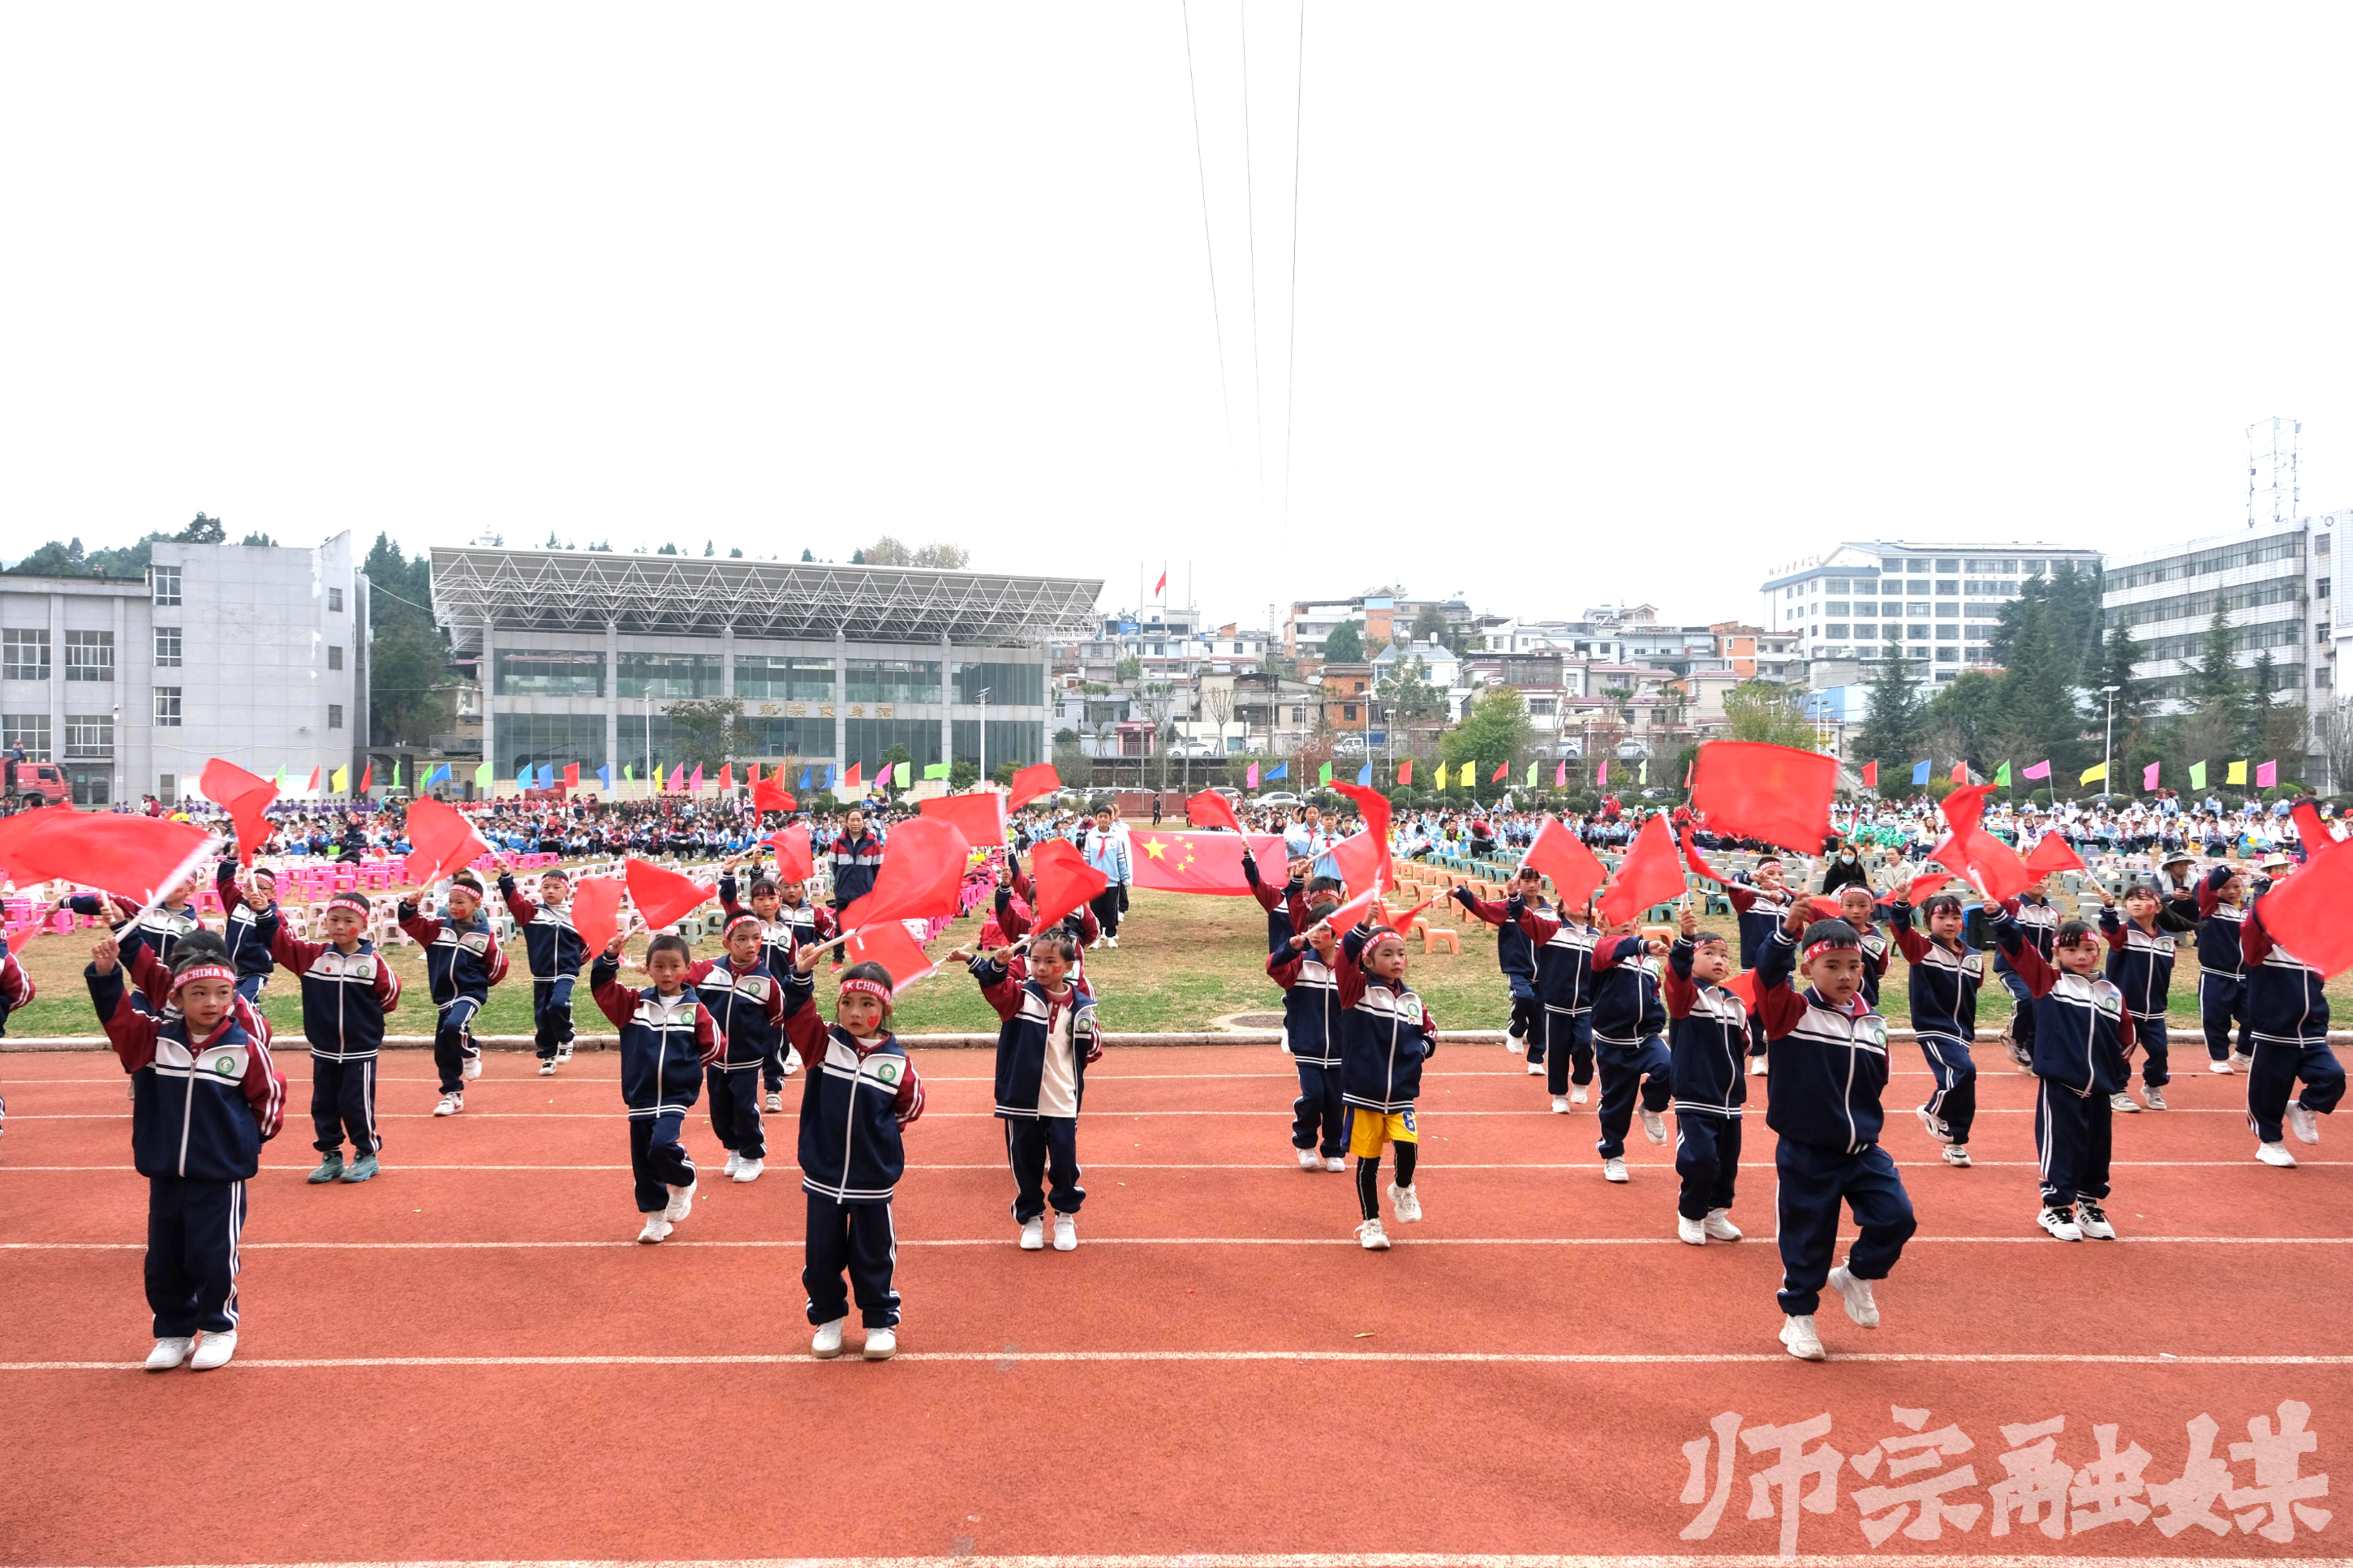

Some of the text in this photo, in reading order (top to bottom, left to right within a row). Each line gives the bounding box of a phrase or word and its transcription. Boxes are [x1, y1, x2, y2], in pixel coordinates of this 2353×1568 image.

[352, 902, 368, 916] BABY
[855, 980, 884, 997] CHINA
[1402, 1110, 1416, 1132] 6
